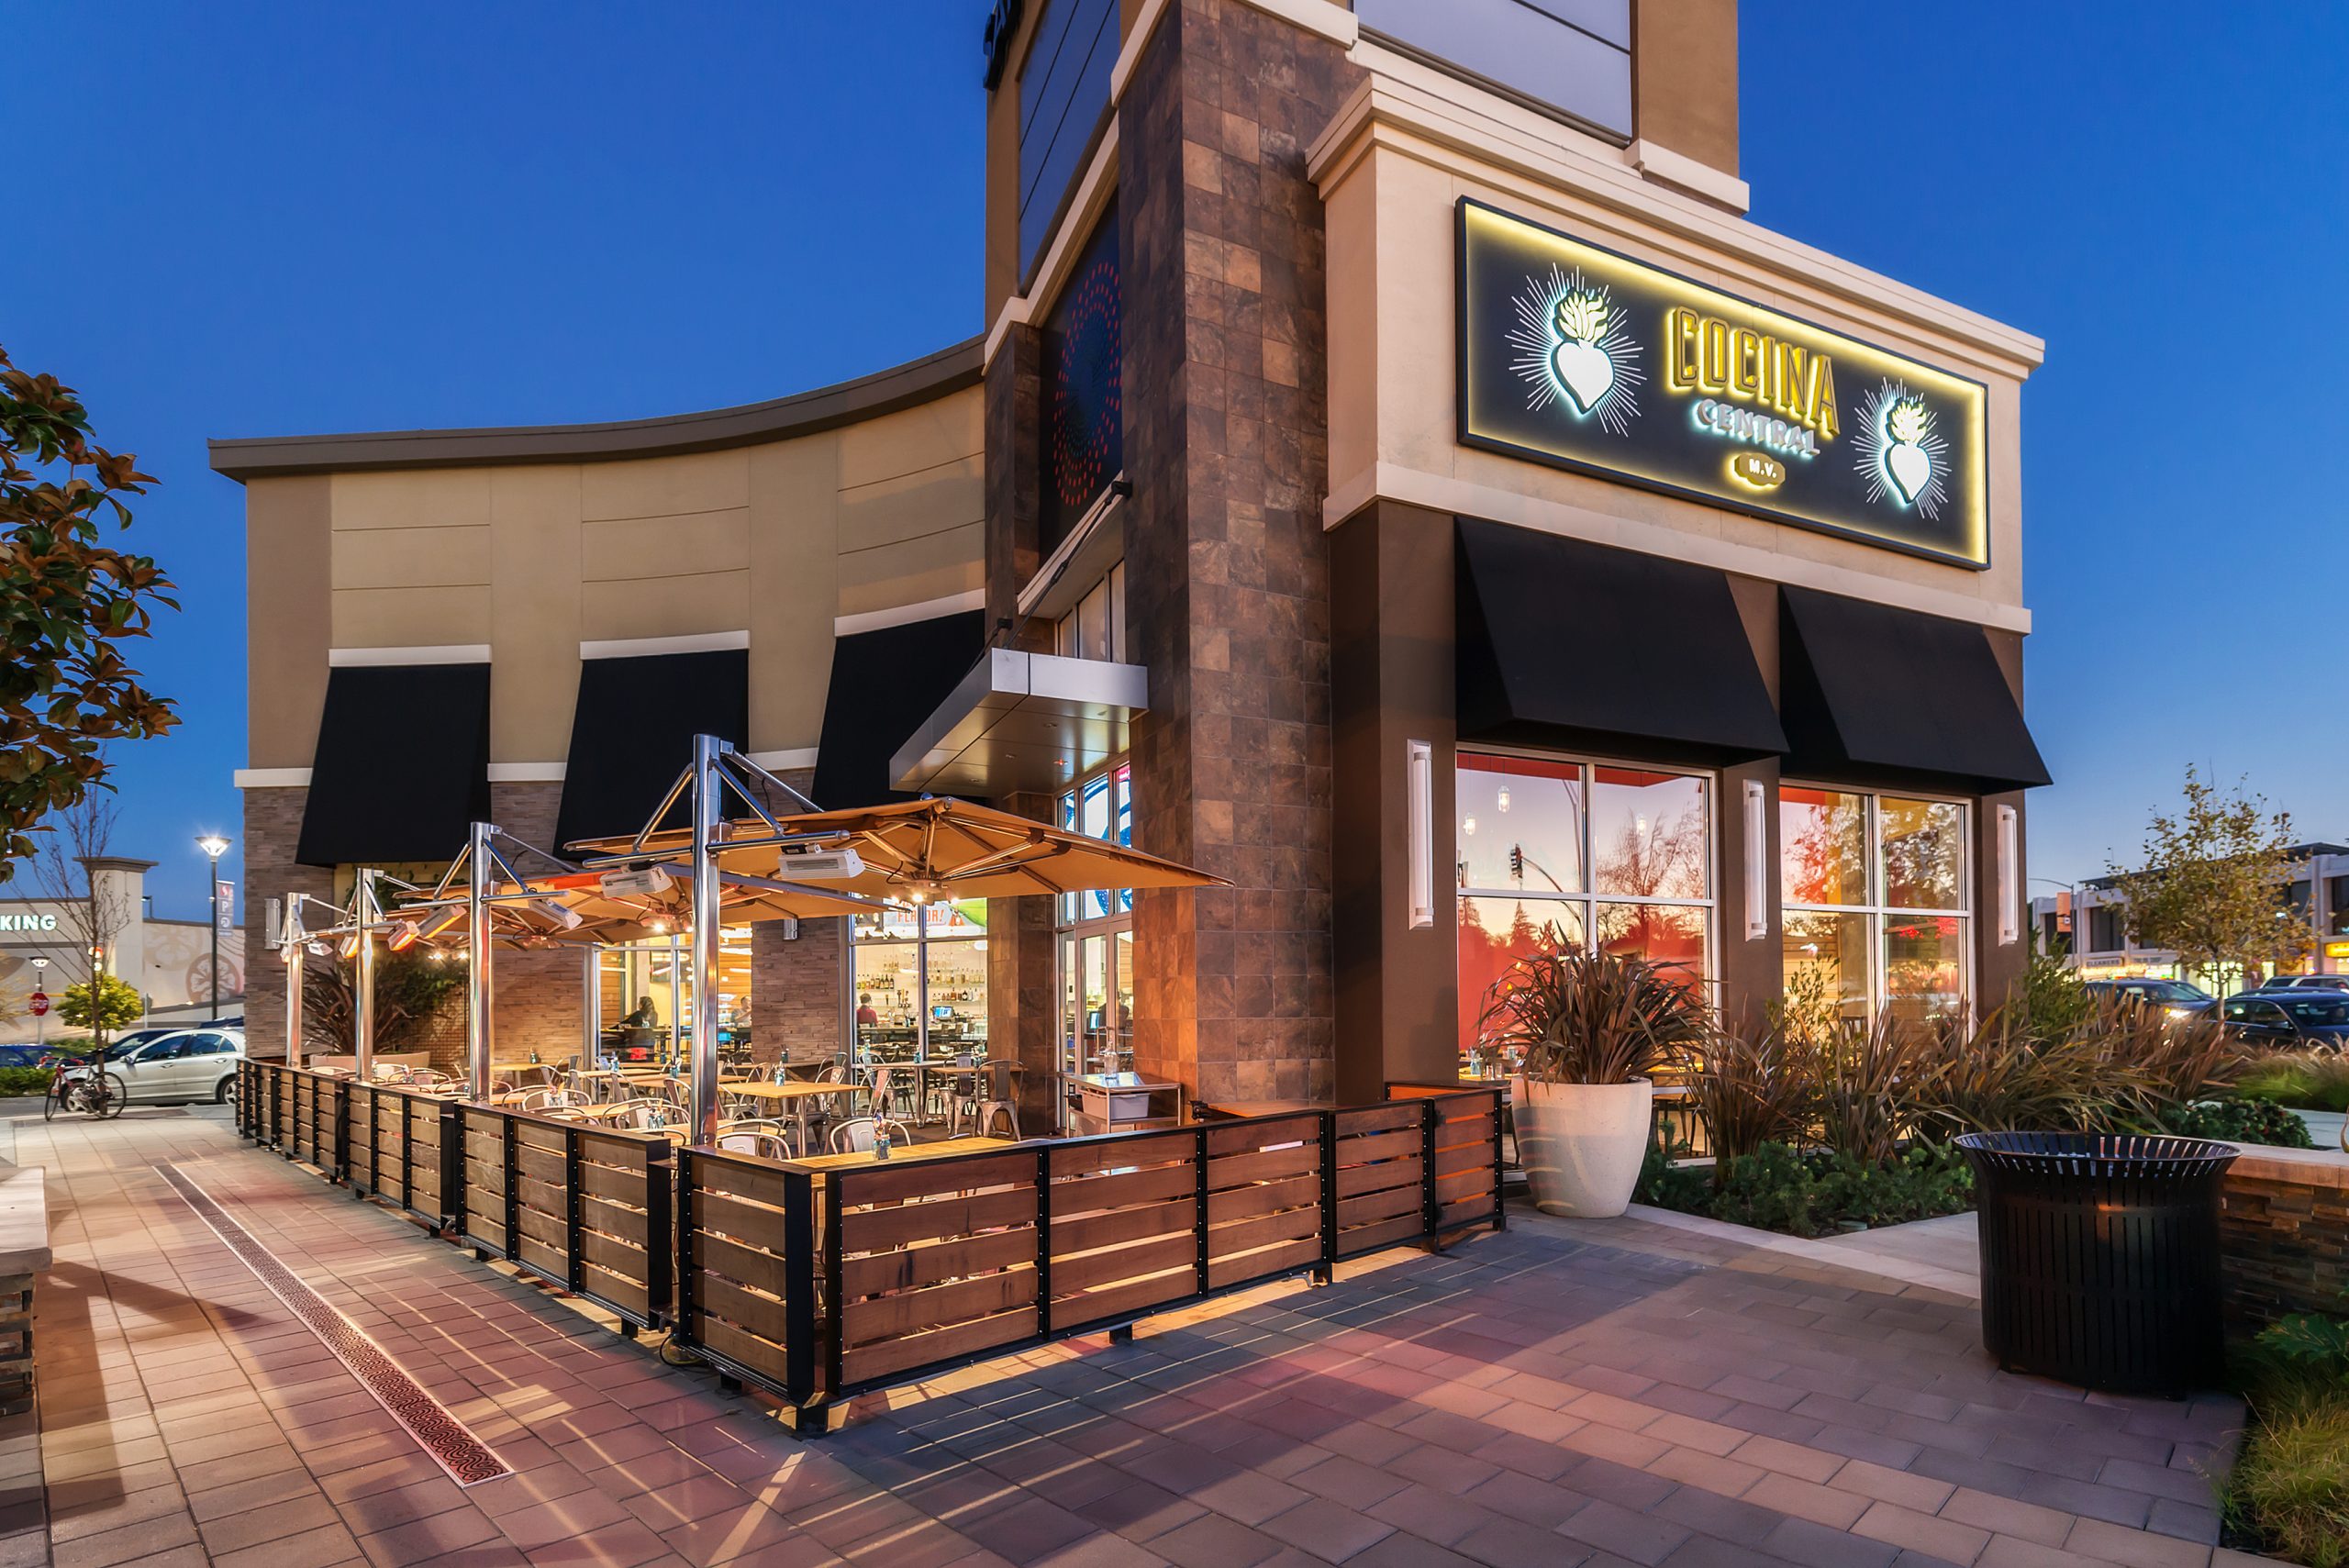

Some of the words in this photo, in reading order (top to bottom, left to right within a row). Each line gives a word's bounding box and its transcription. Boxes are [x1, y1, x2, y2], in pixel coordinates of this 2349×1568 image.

[1673, 306, 1840, 436] COCINA
[1698, 398, 1820, 456] CENTRAL
[1749, 459, 1776, 478] M.V.
[0, 914, 57, 931] KING
[897, 909, 945, 923] FLAOR!
